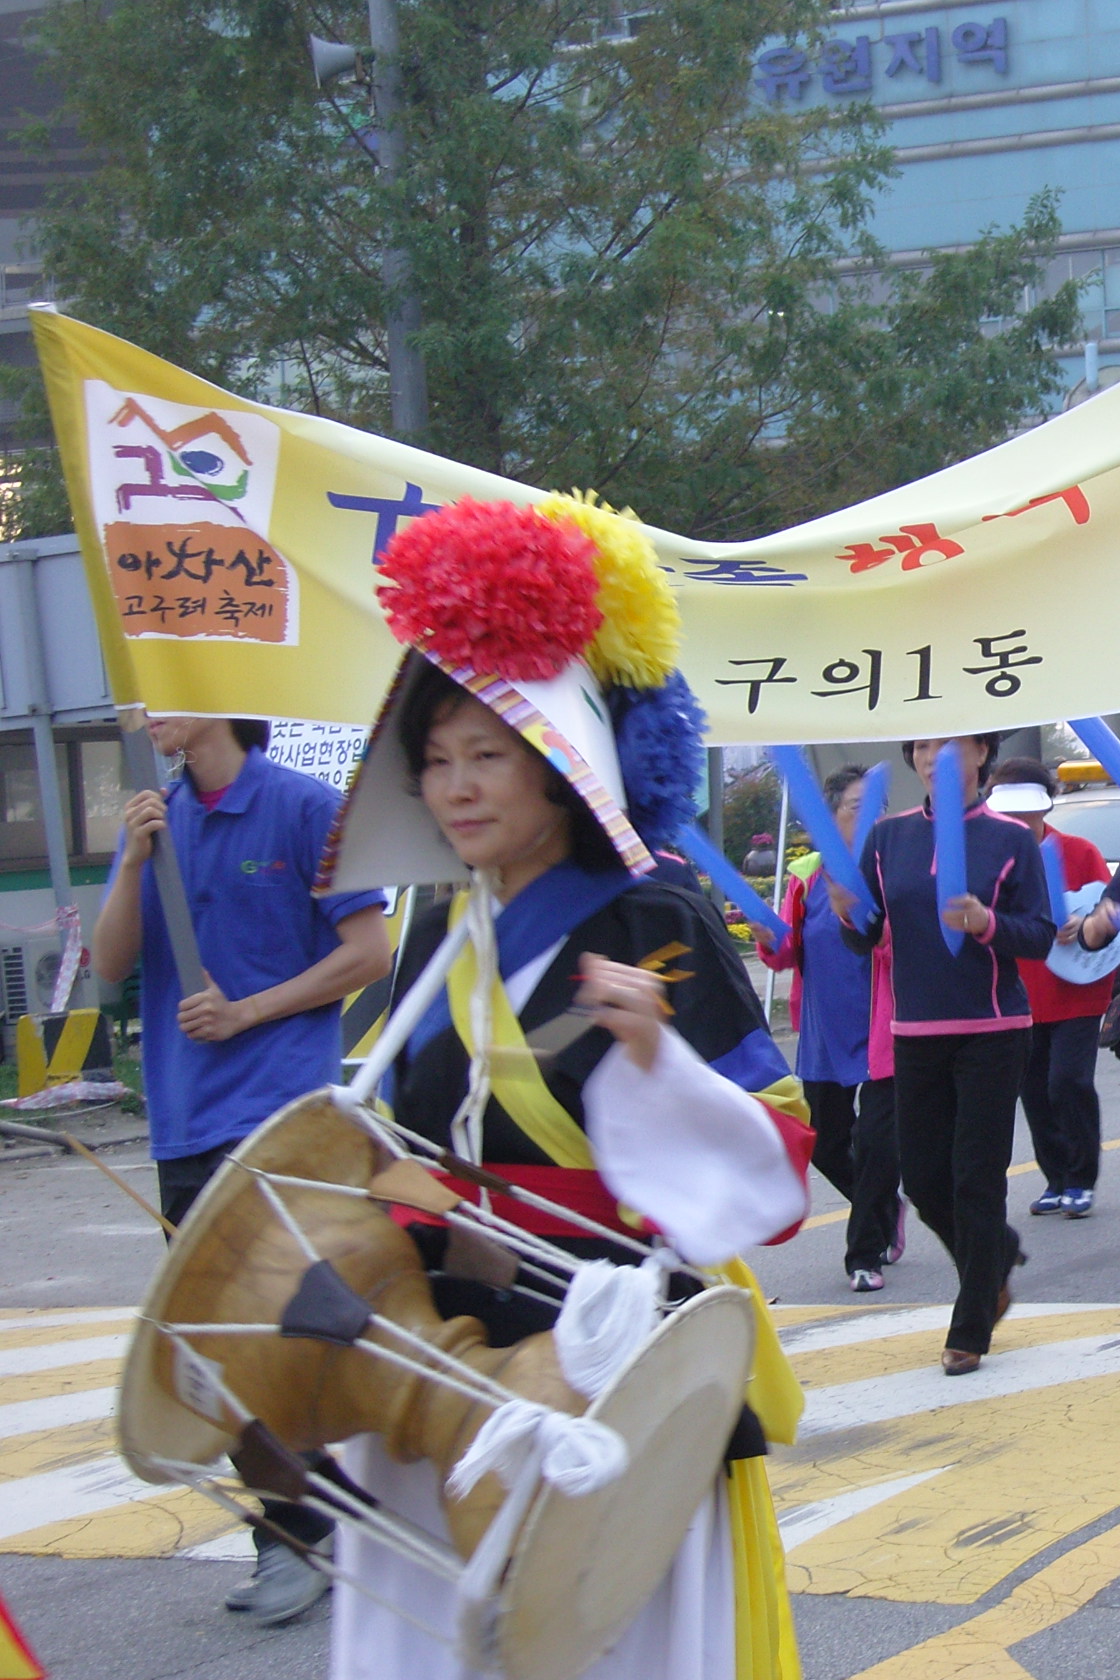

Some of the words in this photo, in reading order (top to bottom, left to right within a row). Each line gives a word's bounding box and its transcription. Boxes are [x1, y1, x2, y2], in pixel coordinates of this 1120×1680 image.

[754, 17, 1009, 100] 유원지역
[118, 537, 275, 587] 아차산
[122, 595, 206, 623] 고구려
[214, 589, 274, 627] 축제
[714, 629, 1043, 714] 구의1동
